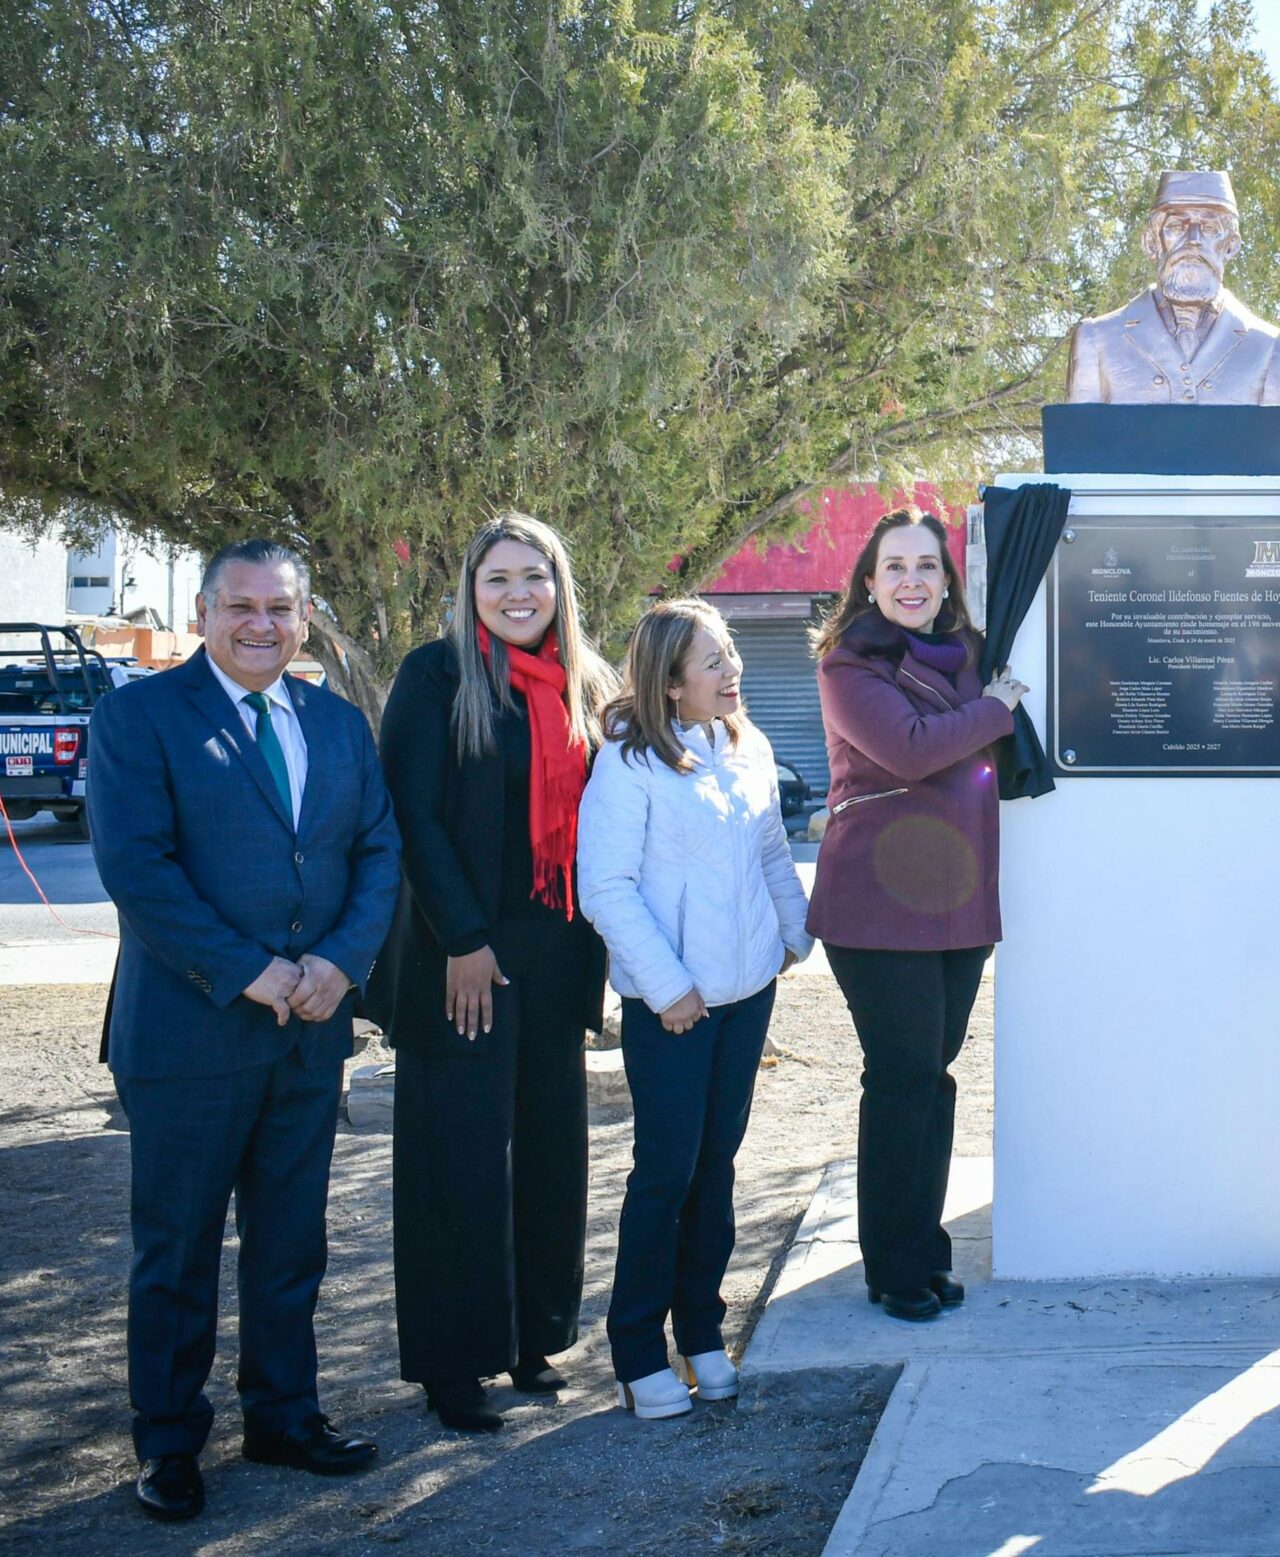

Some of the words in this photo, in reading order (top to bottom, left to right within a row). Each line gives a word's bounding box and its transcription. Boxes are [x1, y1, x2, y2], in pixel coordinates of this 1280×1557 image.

[1088, 590, 1127, 602] Teniente
[1129, 590, 1166, 602] Coronel
[1168, 590, 1212, 602] Ildefonso
[1213, 590, 1249, 602] Fuentes
[1251, 590, 1263, 602] de
[1214, 613, 1242, 621] ejemplar
[1244, 613, 1272, 621] servicio,
[1134, 621, 1179, 629] Ayuntamiento
[1198, 621, 1230, 629] homenaje
[1148, 656, 1161, 664] Lic.
[1163, 656, 1184, 664] Carlos
[1185, 656, 1215, 664] Villarreal
[1217, 656, 1235, 664] Pérez
